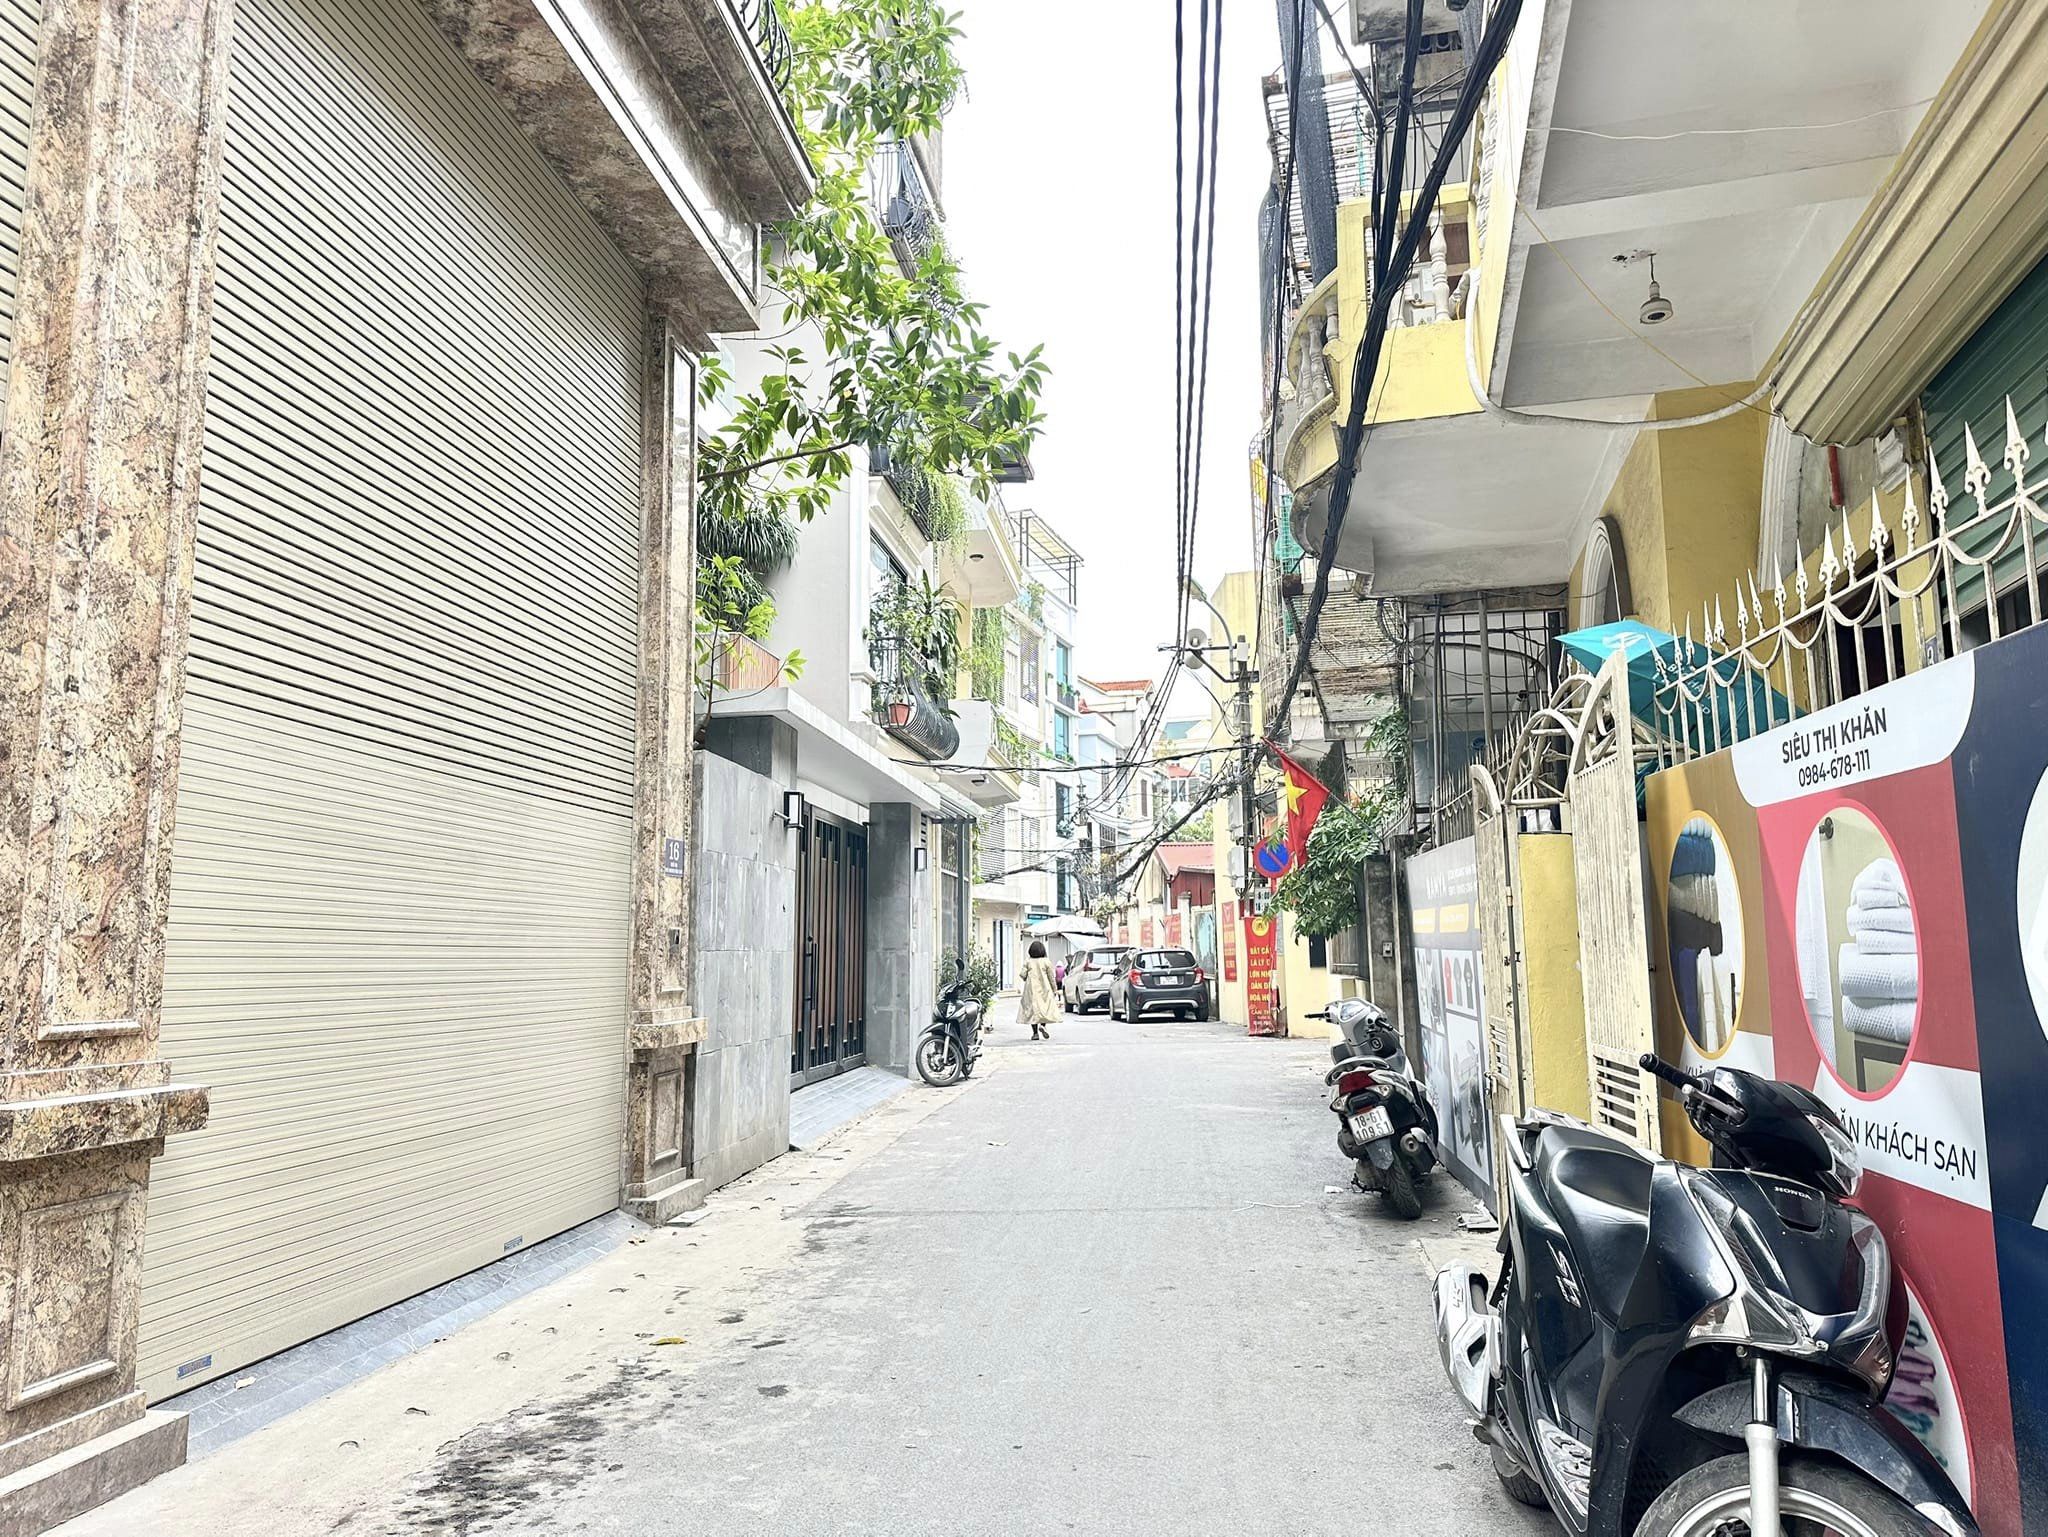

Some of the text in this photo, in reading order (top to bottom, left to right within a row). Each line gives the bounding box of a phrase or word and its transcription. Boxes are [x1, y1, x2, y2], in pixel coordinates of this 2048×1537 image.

[1782, 705, 1888, 764] SIÊU THỊ KHĂN
[1798, 748, 1871, 788] 0984-678-111
[669, 841, 680, 861] 16
[1865, 1121, 1928, 1166] KHÁCH
[1934, 1139, 1977, 1182] SẠN
[1774, 1186, 1812, 1200] HONDA
